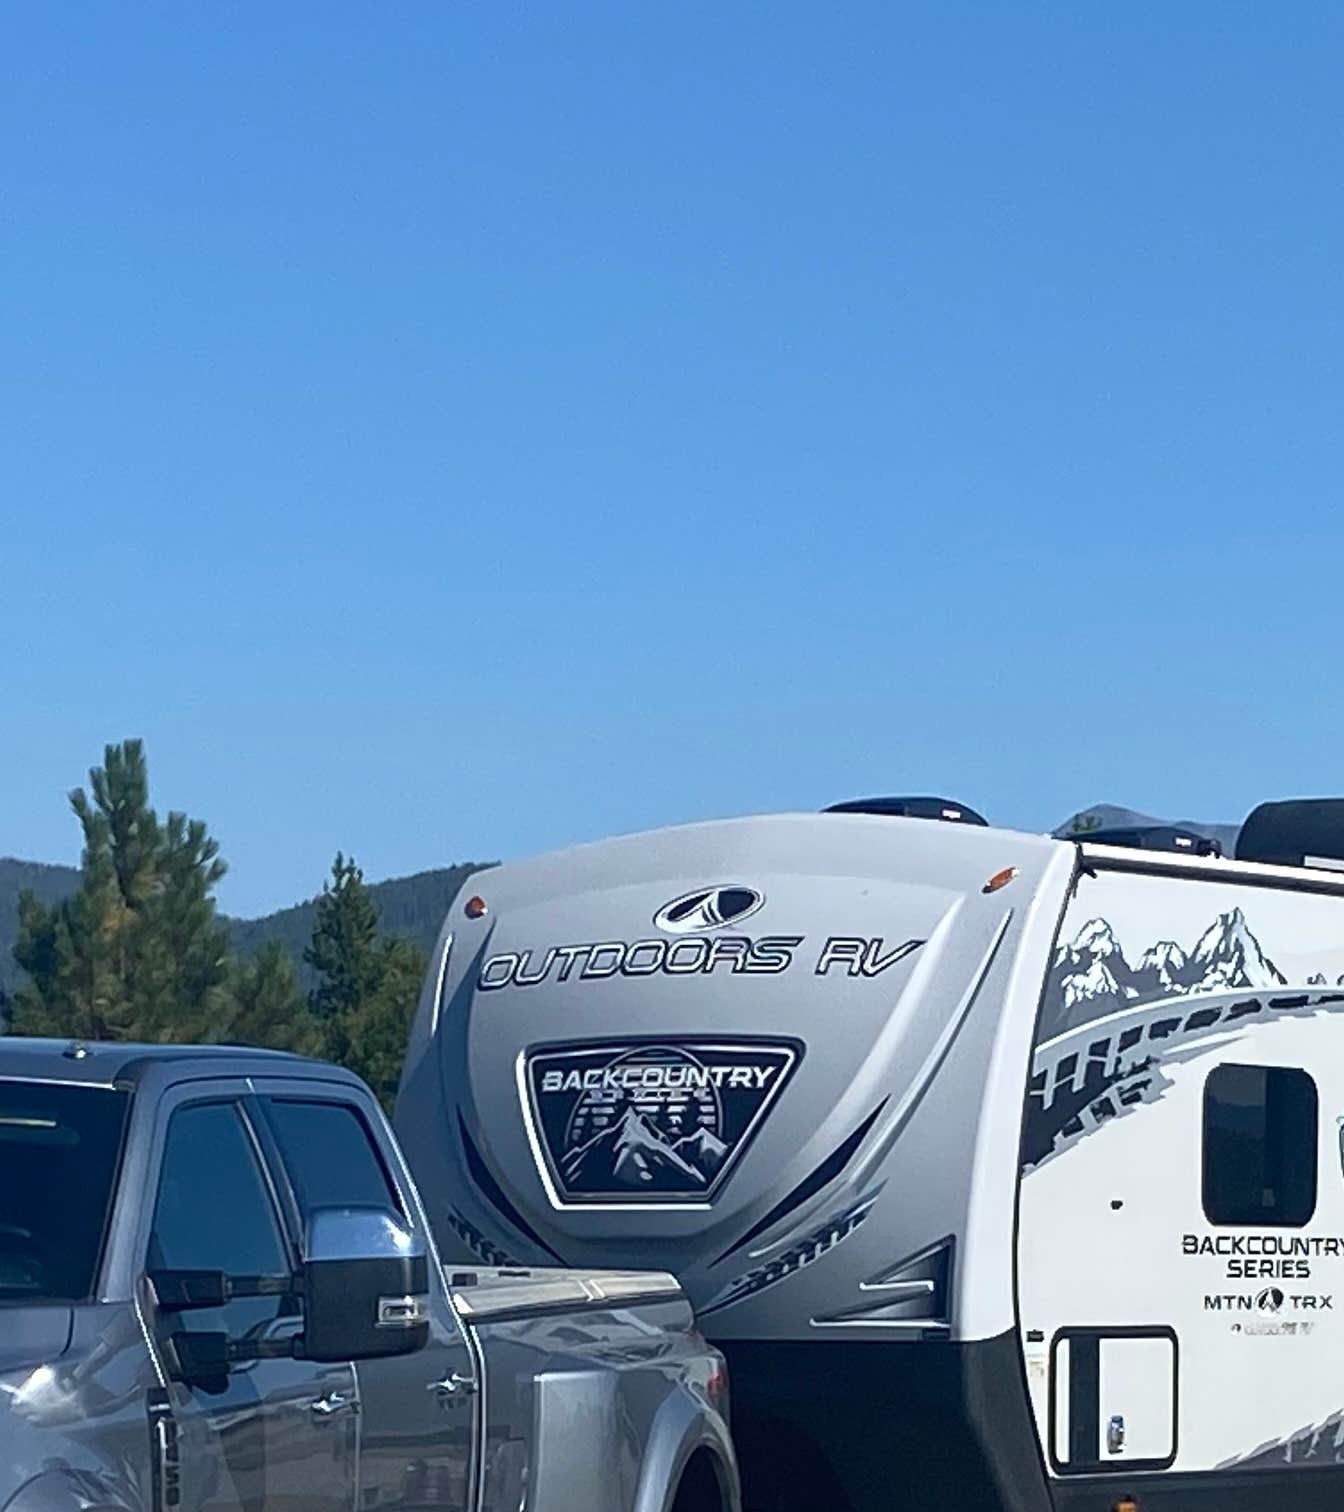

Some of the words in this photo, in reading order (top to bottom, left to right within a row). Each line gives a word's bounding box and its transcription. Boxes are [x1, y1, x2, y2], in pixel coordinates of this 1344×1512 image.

[477, 936, 805, 991] OUTDOORS
[815, 937, 928, 977] RV
[542, 1065, 777, 1092] BACKCOUNTRY
[1226, 1259, 1311, 1278] SERIES
[1204, 1294, 1252, 1310] MTN
[1289, 1294, 1333, 1310] TRX
